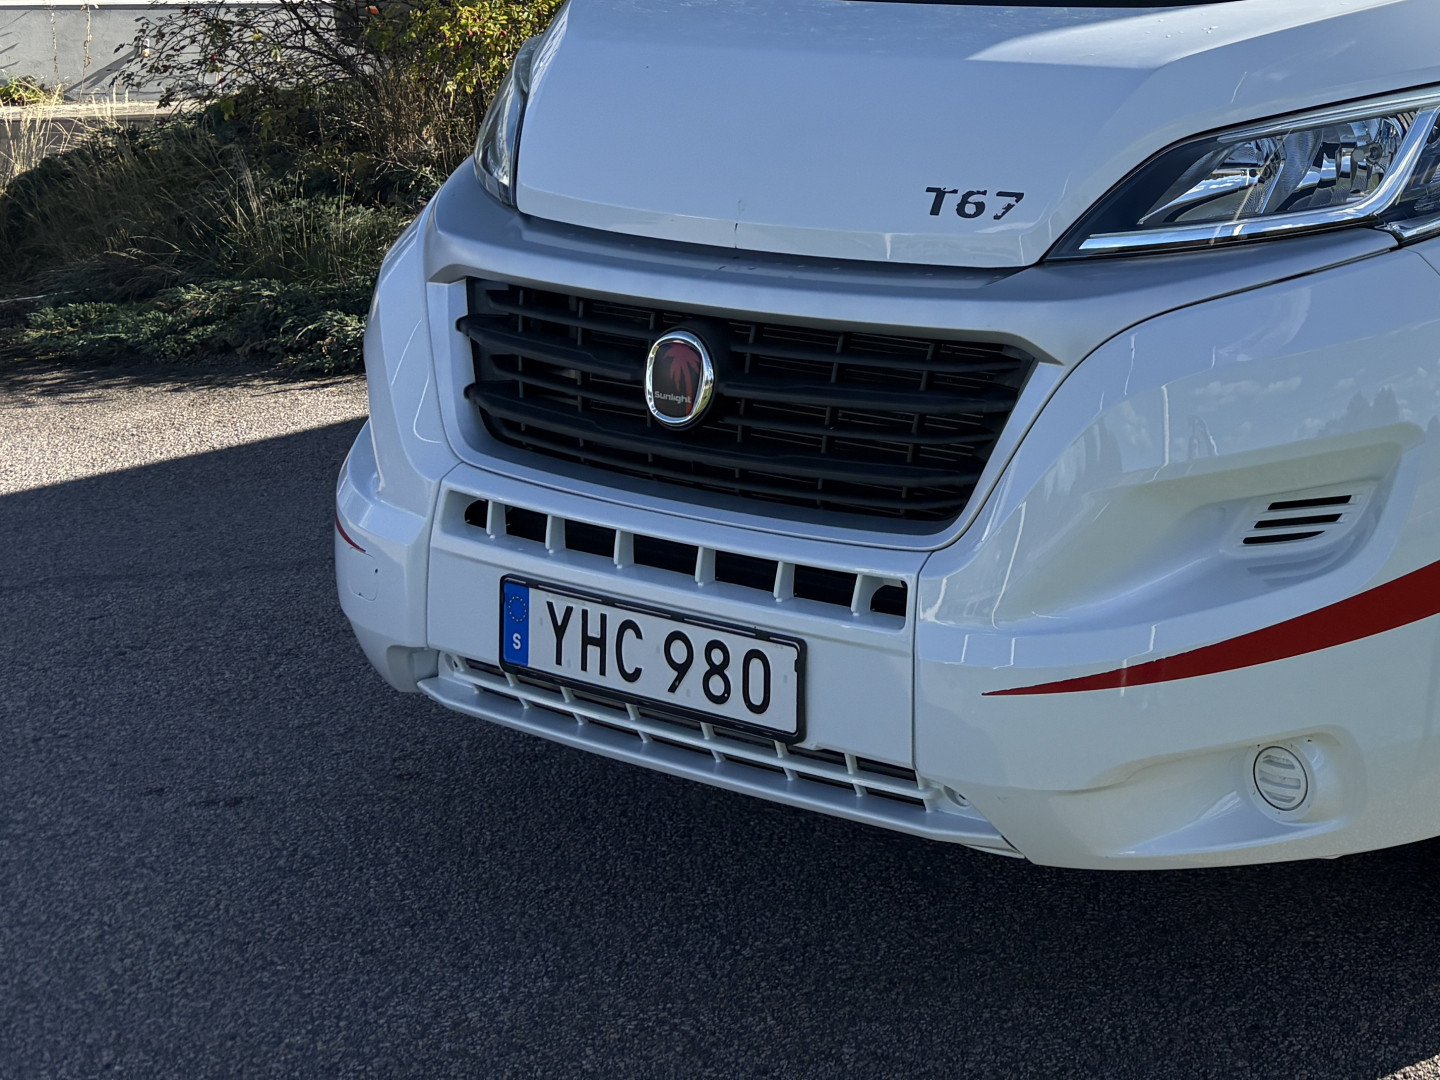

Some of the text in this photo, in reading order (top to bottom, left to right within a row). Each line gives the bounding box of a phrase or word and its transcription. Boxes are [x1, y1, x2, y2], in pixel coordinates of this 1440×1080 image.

[925, 186, 1025, 221] T67
[654, 390, 692, 404] Sunlight
[512, 633, 521, 650] S
[546, 601, 771, 715] YHC 980
